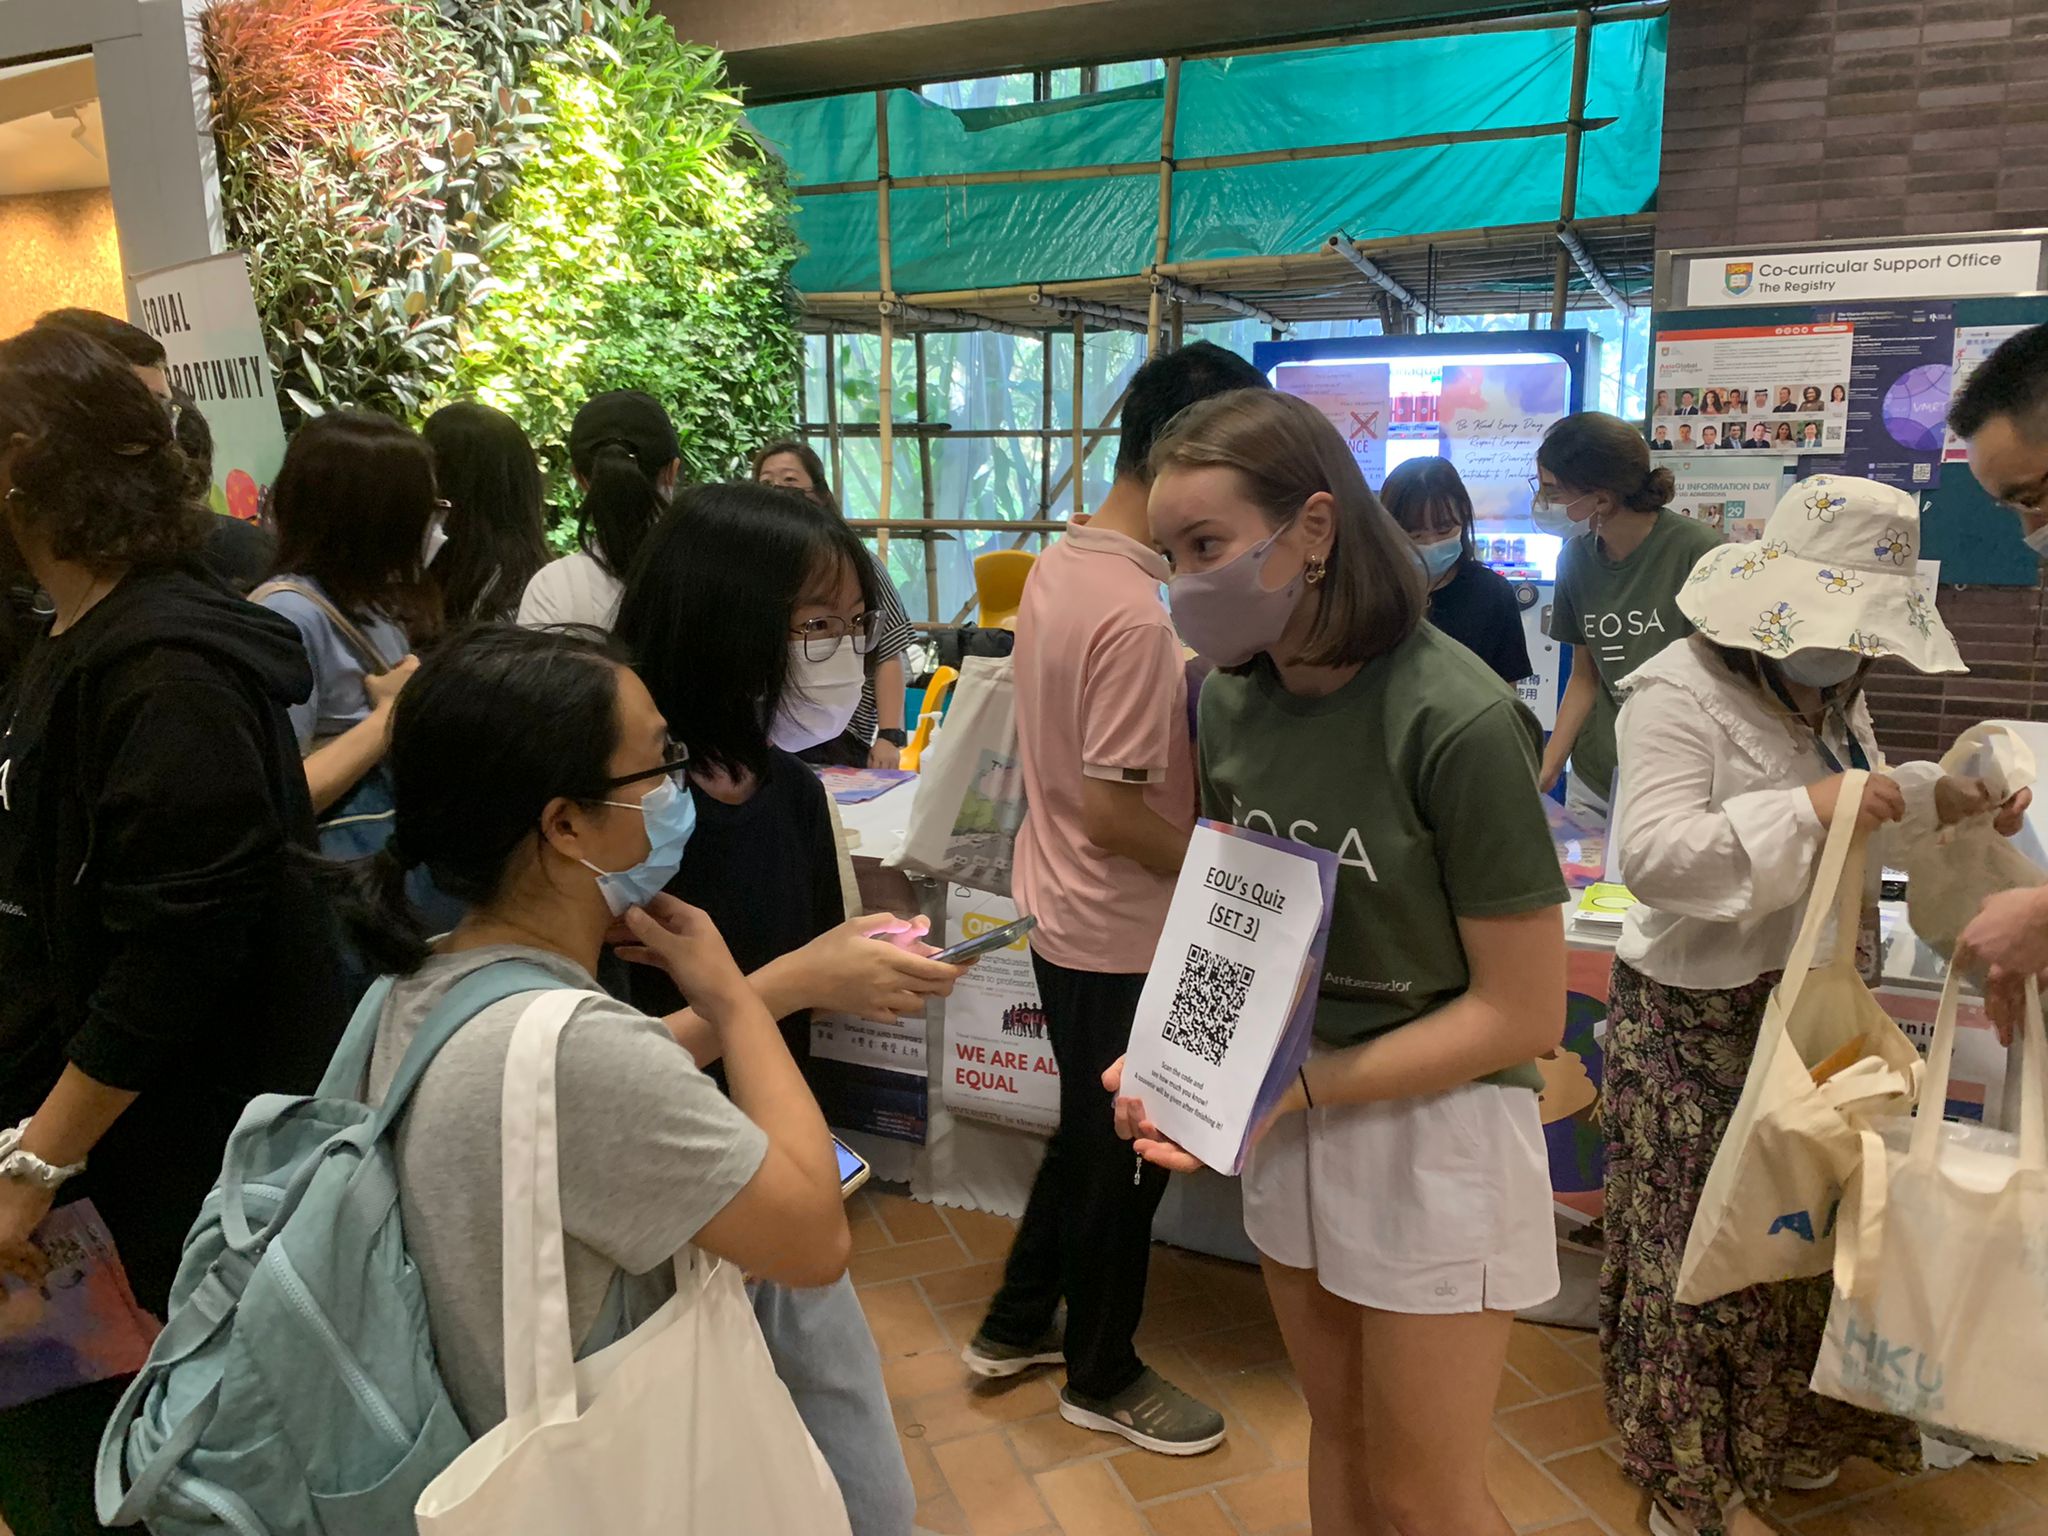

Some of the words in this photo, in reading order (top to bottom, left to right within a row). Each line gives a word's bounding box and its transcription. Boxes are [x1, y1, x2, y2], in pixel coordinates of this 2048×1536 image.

[1758, 261, 1869, 278] Co-curricular
[1873, 255, 1942, 273] Support
[1947, 252, 2002, 269] Office
[1758, 281, 1781, 294] The
[1784, 279, 1836, 294] Registry
[142, 292, 191, 337] EQUAL
[164, 355, 264, 402] PPORTUNITY
[1473, 418, 1494, 431] Kind
[1523, 418, 1545, 432] Day
[1687, 482, 1751, 490] INFORMATION
[1752, 482, 1771, 490] DAY
[1727, 506, 1743, 517] 29
[1583, 607, 1666, 639] EOSA
[1232, 793, 1379, 883] OSA
[1251, 883, 1286, 910] Quiz
[1209, 902, 1244, 930] (SET
[1243, 915, 1260, 940] 3)
[1324, 972, 1412, 993] Ambassador
[955, 1043, 986, 1064] WE
[989, 1050, 1029, 1071] ARE
[1032, 1056, 1062, 1077] AL
[955, 1067, 1019, 1094] EQUAL
[1172, 1066, 1181, 1078] the
[1181, 1073, 1193, 1085] code
[1844, 1317, 1944, 1394] HKU
